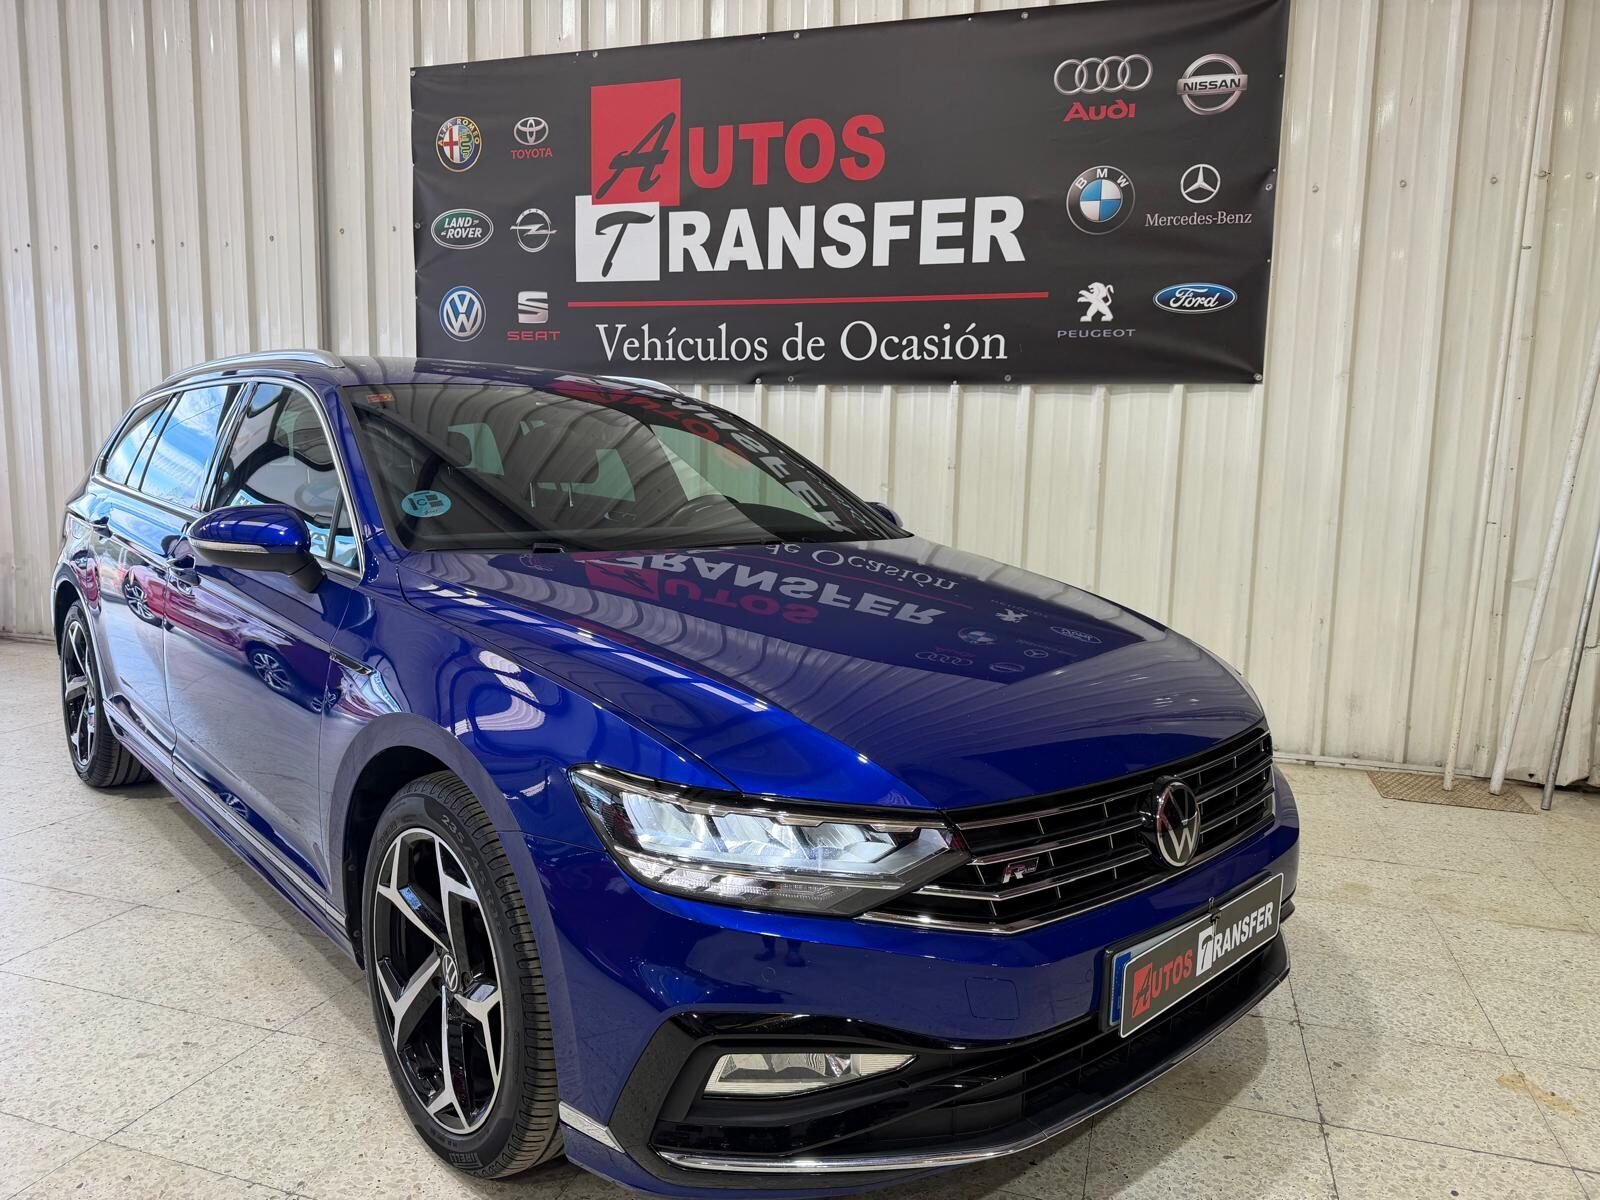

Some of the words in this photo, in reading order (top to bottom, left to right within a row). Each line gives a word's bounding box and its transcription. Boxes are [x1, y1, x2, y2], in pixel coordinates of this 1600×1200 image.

[1183, 78, 1241, 91] NISSAN
[1063, 99, 1136, 122] Audi
[457, 118, 480, 145] ROMEO
[511, 148, 553, 159] TOYOTA
[594, 111, 885, 200] AUTOS
[1075, 167, 1129, 189] BMW
[444, 218, 473, 228] LAND
[1144, 210, 1252, 227] Mercedes-Benz
[446, 227, 482, 239] ROVER
[594, 195, 1026, 278] TRANSFER
[1169, 288, 1221, 308] Ford
[507, 330, 560, 341] SEAT
[596, 321, 768, 362] Vehículos
[781, 321, 825, 362] de
[840, 320, 1008, 362] Ocasión
[1057, 328, 1136, 339] PEUGEOT
[1132, 948, 1194, 1018] AUTOS
[1198, 901, 1274, 974] TRANSFER
